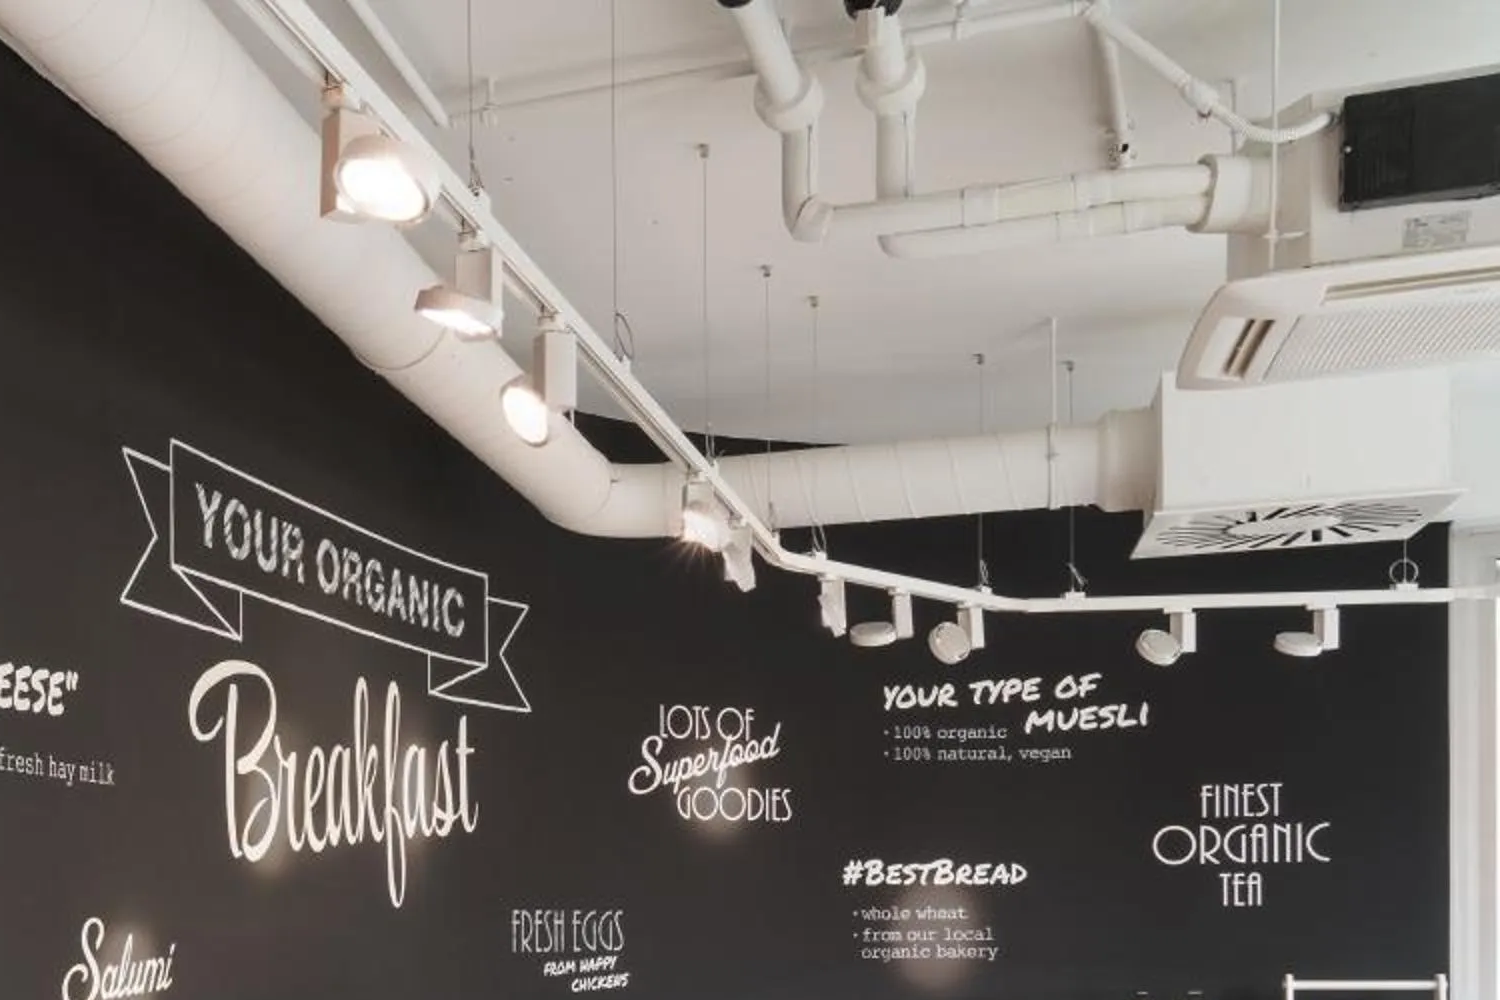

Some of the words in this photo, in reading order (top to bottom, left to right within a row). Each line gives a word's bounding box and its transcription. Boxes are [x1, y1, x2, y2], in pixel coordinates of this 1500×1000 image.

[195, 482, 305, 585] YOUR
[316, 538, 465, 638] ORGANIC
[883, 683, 958, 711] YOUR
[968, 677, 1042, 705] TYPE
[1054, 672, 1102, 700] OF
[659, 704, 711, 741] LOTS
[716, 707, 755, 742] OF
[894, 725, 931, 740] 100%
[937, 725, 1008, 743] organic
[1024, 701, 1150, 734] MUESLI
[48, 755, 76, 787] hay
[79, 760, 115, 785] milk
[627, 721, 782, 795] Superfood
[894, 746, 932, 761] 100%
[937, 745, 1013, 762] natural,
[1018, 747, 1072, 763] vegan
[188, 660, 479, 909] Breakfast
[1200, 782, 1283, 819] FINEST
[676, 785, 793, 822] GOODIES
[1152, 822, 1331, 866] ORGANIC
[842, 858, 1028, 887] #BESTBREAD
[1219, 871, 1262, 907] TEA
[861, 905, 912, 922] whole
[915, 905, 969, 920] wheat
[511, 909, 565, 953] FRESH
[571, 909, 625, 953] EGGS
[862, 927, 903, 942] from
[907, 930, 937, 942] our
[943, 927, 995, 942] local
[543, 960, 577, 977] FROM
[579, 955, 618, 973] HAPPY
[861, 944, 932, 963] organic
[936, 944, 999, 961] bakery
[571, 972, 630, 993] CHICKENS
